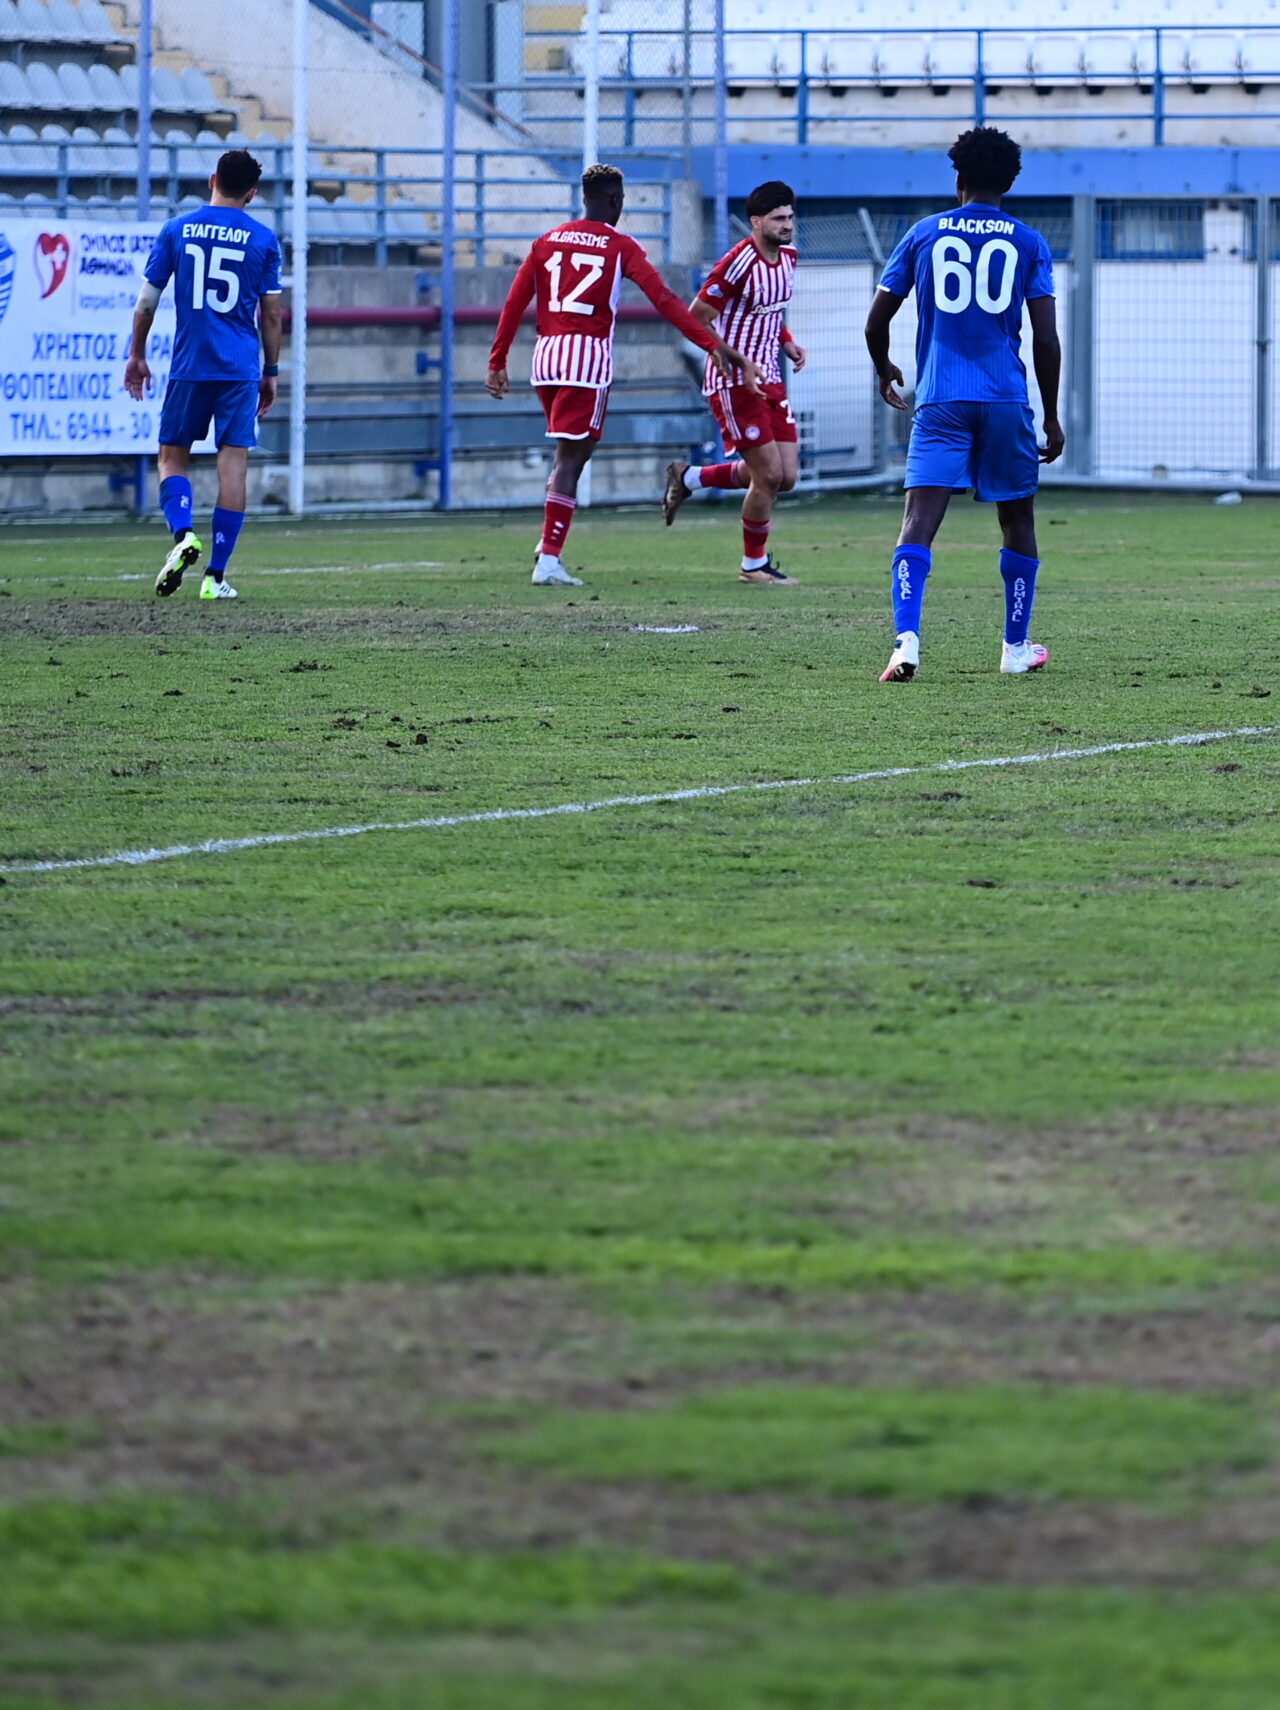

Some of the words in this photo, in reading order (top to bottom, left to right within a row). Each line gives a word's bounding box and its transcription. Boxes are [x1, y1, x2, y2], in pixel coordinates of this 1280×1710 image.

[182, 223, 251, 245] ΕΥΑΓΓΕΛΟΥ
[938, 217, 1015, 235] BLACKSON
[546, 231, 610, 249] ALGASSIME
[185, 243, 246, 313] 15
[543, 251, 605, 315] 12
[932, 235, 1018, 314] 60
[32, 333, 117, 361] ΧΡΗΣΤΟΣ
[0, 373, 112, 400] ΘΟΠΕΔΙΚΟΣ
[67, 412, 111, 439] 6944
[1011, 577, 1026, 622] ADMIRAL
